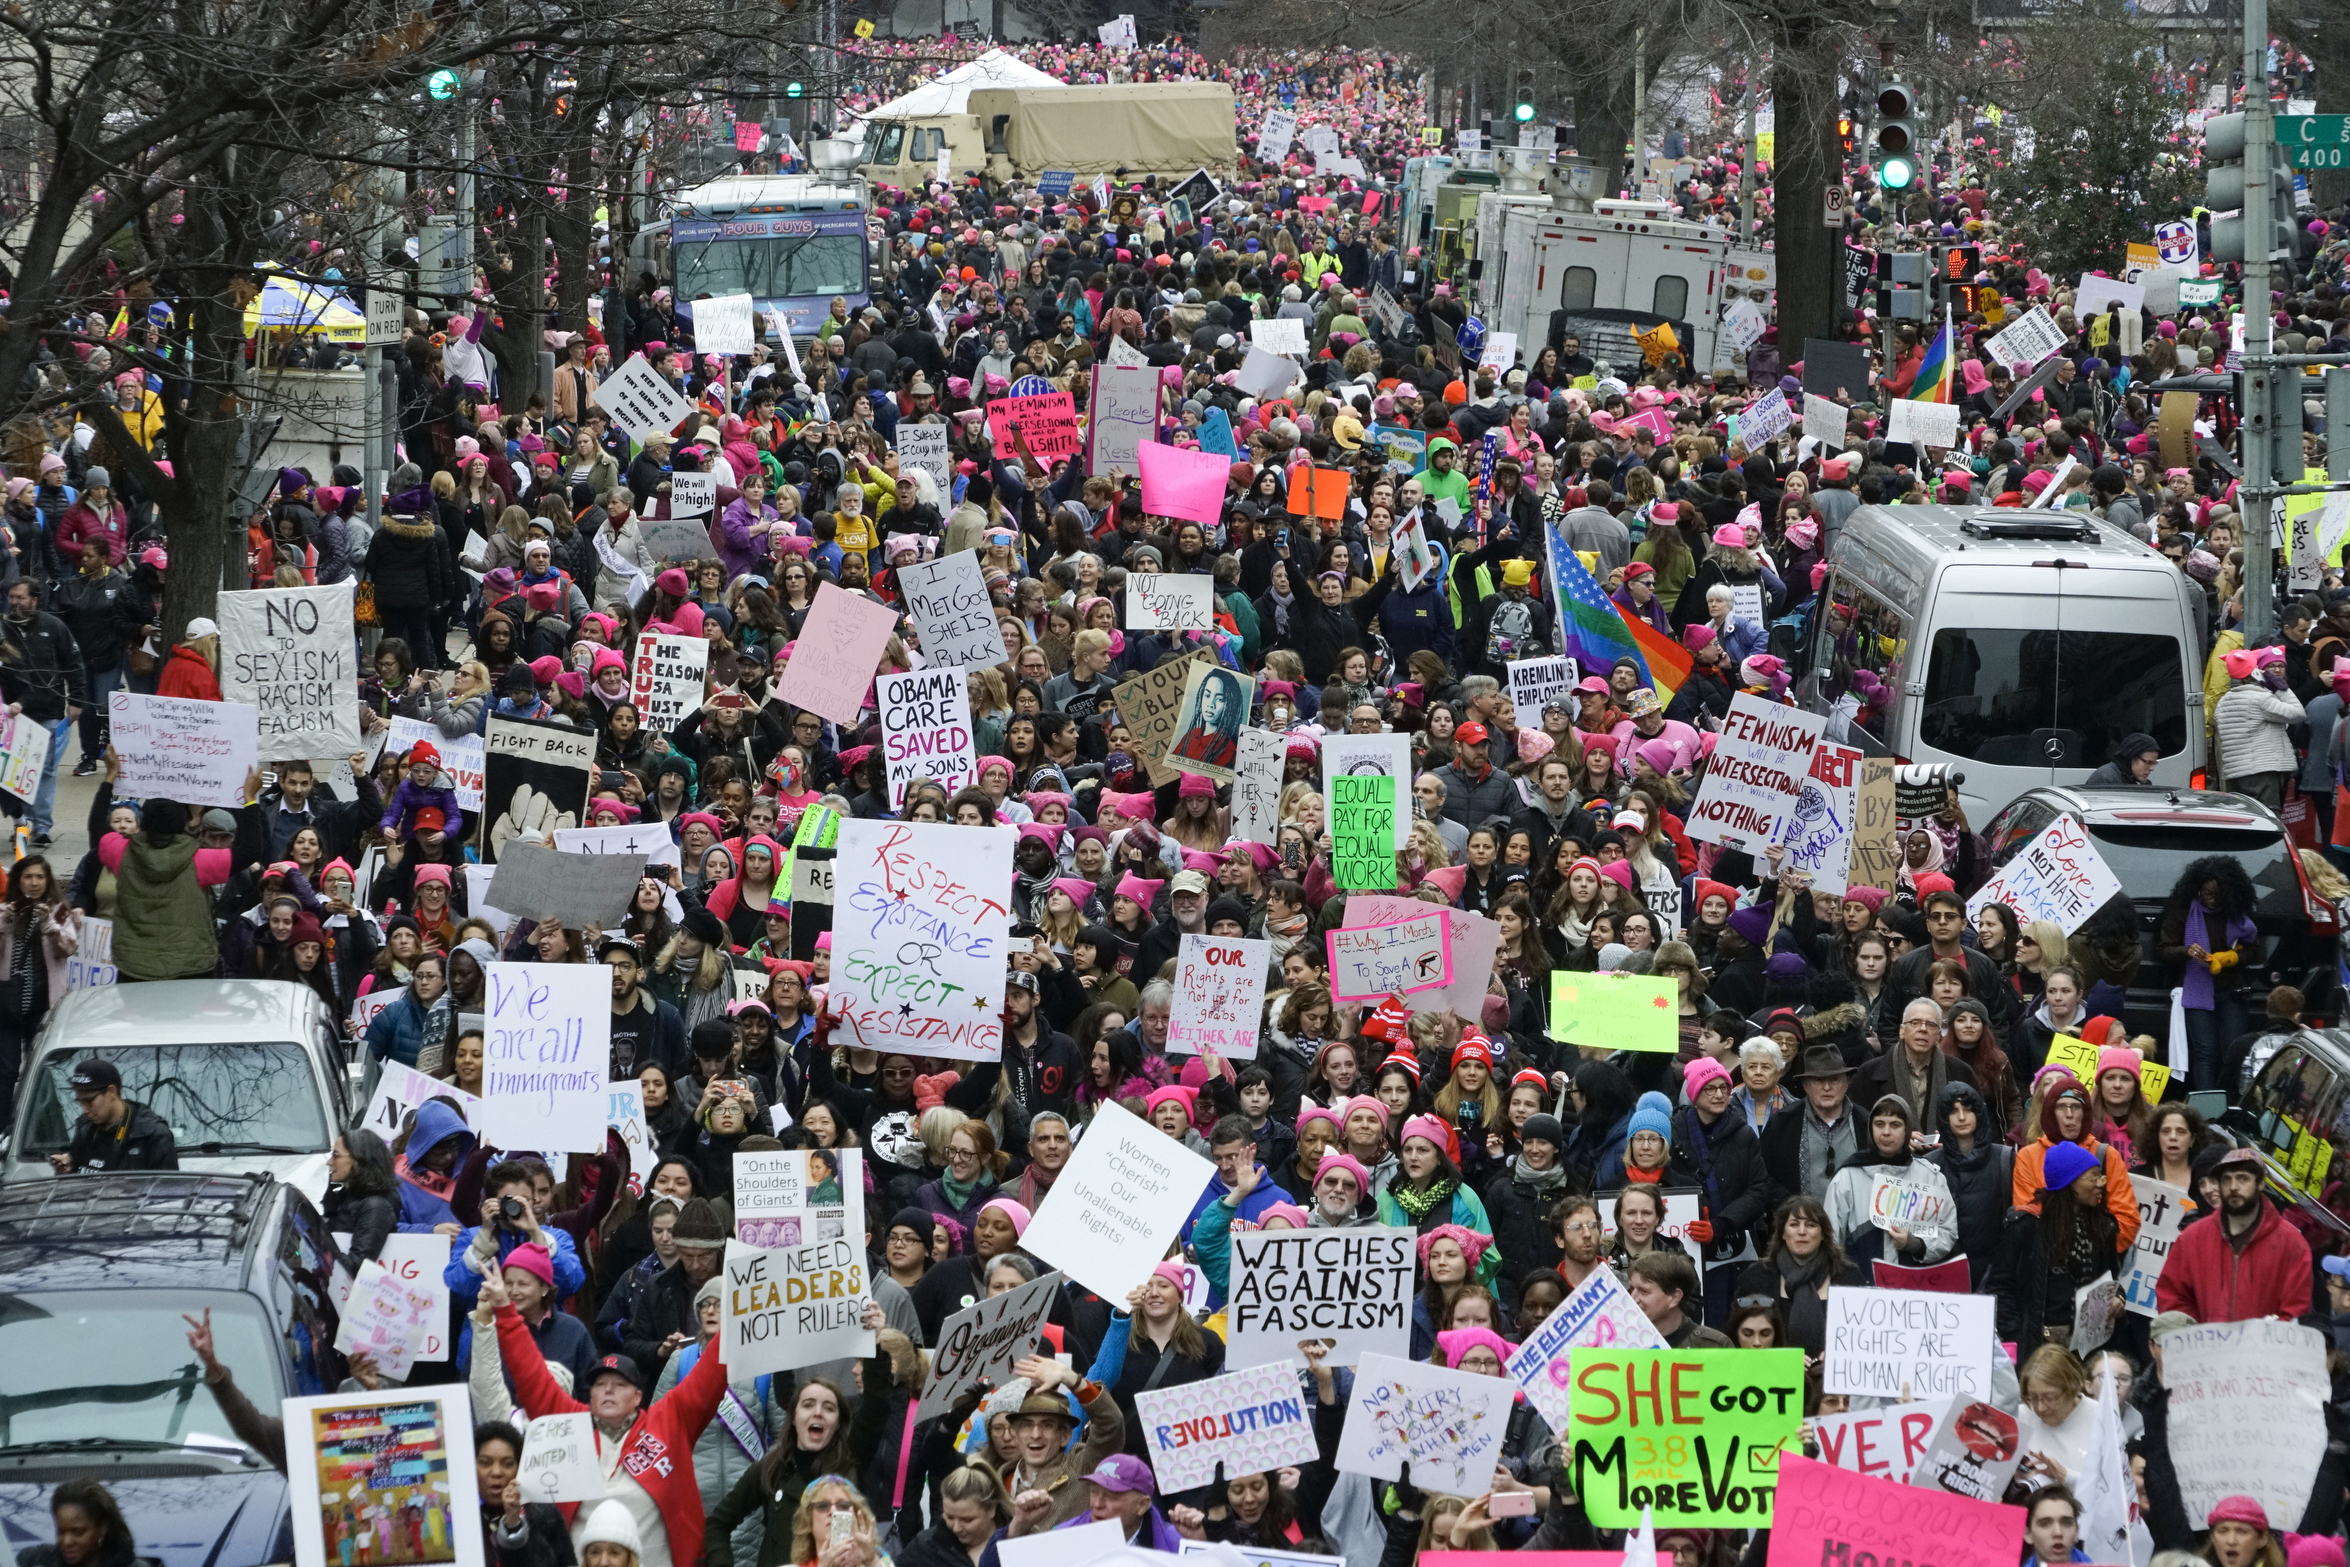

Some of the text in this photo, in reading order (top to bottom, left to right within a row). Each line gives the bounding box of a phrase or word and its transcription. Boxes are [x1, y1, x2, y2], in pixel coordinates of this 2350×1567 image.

[1266, 127, 1279, 136] LIE
[1269, 120, 1285, 131] WILL
[1271, 113, 1296, 126] TRUMP
[2300, 117, 2317, 142] C
[1262, 145, 1277, 156] WILL
[2298, 149, 2342, 167] 400
[1039, 178, 1073, 188] NEIGHBOR
[697, 227, 722, 235] SELECTION
[723, 220, 813, 237] FOUR GUYS
[2127, 259, 2161, 272] NOISY
[374, 300, 397, 315] TURN
[2183, 293, 2214, 301] VOICES
[696, 303, 750, 320] GOVERN
[369, 319, 401, 336] ON RED
[698, 323, 745, 340] IN 140
[1260, 320, 1296, 333] BLACK
[2033, 304, 2067, 344] Never forget
[1263, 331, 1296, 343] LIVES
[618, 391, 629, 401] OF
[624, 374, 671, 424] TINY HANDS OFF
[640, 372, 674, 408] KEEP YOUR
[1011, 397, 1068, 413] FEMINISM
[613, 406, 637, 429] RIGHTS
[1944, 451, 1974, 469] WOMAN
[674, 477, 706, 489] We will
[674, 491, 716, 509] go high!
[843, 533, 869, 546] LOVE
[921, 561, 947, 586] I
[1127, 573, 1164, 595] NOT
[1142, 593, 1195, 611] GOING
[1744, 599, 1759, 607] come
[1746, 590, 1759, 599] time
[265, 597, 320, 637] NO
[837, 592, 870, 624] WE
[911, 594, 951, 622] MET
[1155, 610, 1207, 629] BACK
[928, 611, 992, 646] SHE IS
[276, 636, 296, 652] TO
[640, 636, 682, 660] THE
[934, 640, 1001, 670] BLACK
[234, 650, 342, 684] SEXISM
[636, 656, 706, 684] REASON
[796, 643, 874, 694] NASTY
[257, 681, 335, 711] RACISM
[635, 675, 673, 697] USA
[888, 673, 962, 706] OBAMA-
[633, 693, 684, 716] MUST
[885, 699, 958, 732] CARE
[1769, 703, 1791, 720] MY
[257, 710, 336, 736] FACISM
[1723, 710, 1818, 756] FEMINISM
[489, 732, 588, 757] FIGHT BACK
[887, 726, 969, 762] SAVED
[1248, 738, 1266, 755] I'M
[1747, 744, 1791, 766] WILL BE
[892, 754, 969, 782] MY SON'S
[1175, 756, 1228, 775] WE THE PEOPLE
[1243, 761, 1265, 777] WITH
[1706, 752, 1804, 798] INTERSECTIONAL
[1241, 783, 1264, 802] HER
[1334, 779, 1392, 805] EQUAL
[1719, 780, 1780, 803] OR IT WILL BE
[1921, 786, 1945, 796] PENCE
[1333, 808, 1393, 836] PAY FOR
[1335, 835, 1392, 860] EQUAL
[2044, 817, 2094, 900] Love
[1336, 860, 1396, 888] WORK
[2029, 847, 2083, 919] NOT HATE
[896, 941, 943, 977] OR
[1205, 946, 1247, 969] OUR
[1374, 960, 1402, 976] Save
[1183, 963, 1254, 991] Rights are
[490, 968, 550, 1022] We
[1187, 987, 1251, 1006] not for
[833, 991, 1002, 1052] RESISTANCE
[1167, 1019, 1257, 1048] NEITHER ARE
[488, 1016, 584, 1065] are all
[488, 1063, 601, 1119] immigrants
[741, 1159, 792, 1174] “On the
[1118, 1137, 1172, 1180] Women
[735, 1176, 799, 1191] Shoulders
[1110, 1180, 1138, 1205] Our
[1885, 1176, 1932, 1194] WE ARE
[736, 1191, 799, 1209] of Giants”
[807, 1199, 845, 1209] Rosa Parks
[1073, 1181, 1154, 1240] Unalienable
[815, 1209, 846, 1220] ARRESTED
[1871, 1213, 1888, 1227] AND
[1078, 1209, 1126, 1247] Rights!
[730, 1240, 853, 1287] WE NEED
[1235, 1236, 1410, 1271] WITCHES
[732, 1264, 862, 1317] LEADERS
[1233, 1266, 1413, 1305] AGAINST
[1236, 1301, 1405, 1334] FASCISM
[1841, 1296, 1963, 1331] WOMEN'S
[740, 1309, 787, 1346] NOT
[1510, 1276, 1611, 1380] THE ELEPHANT
[1834, 1325, 1959, 1359] RIGHTS ARE
[1832, 1358, 1979, 1395] HUMAN RIGHTS
[1361, 1385, 1391, 1414] NO
[1575, 1359, 1798, 1429] SHE GOT
[1367, 1438, 1394, 1463] FOR
[1632, 1434, 1690, 1469] 3.8
[1936, 1449, 1962, 1469] MY
[1633, 1466, 1684, 1481] MIL
[1922, 1459, 1948, 1481] MY
[376, 1477, 411, 1489] STORM
